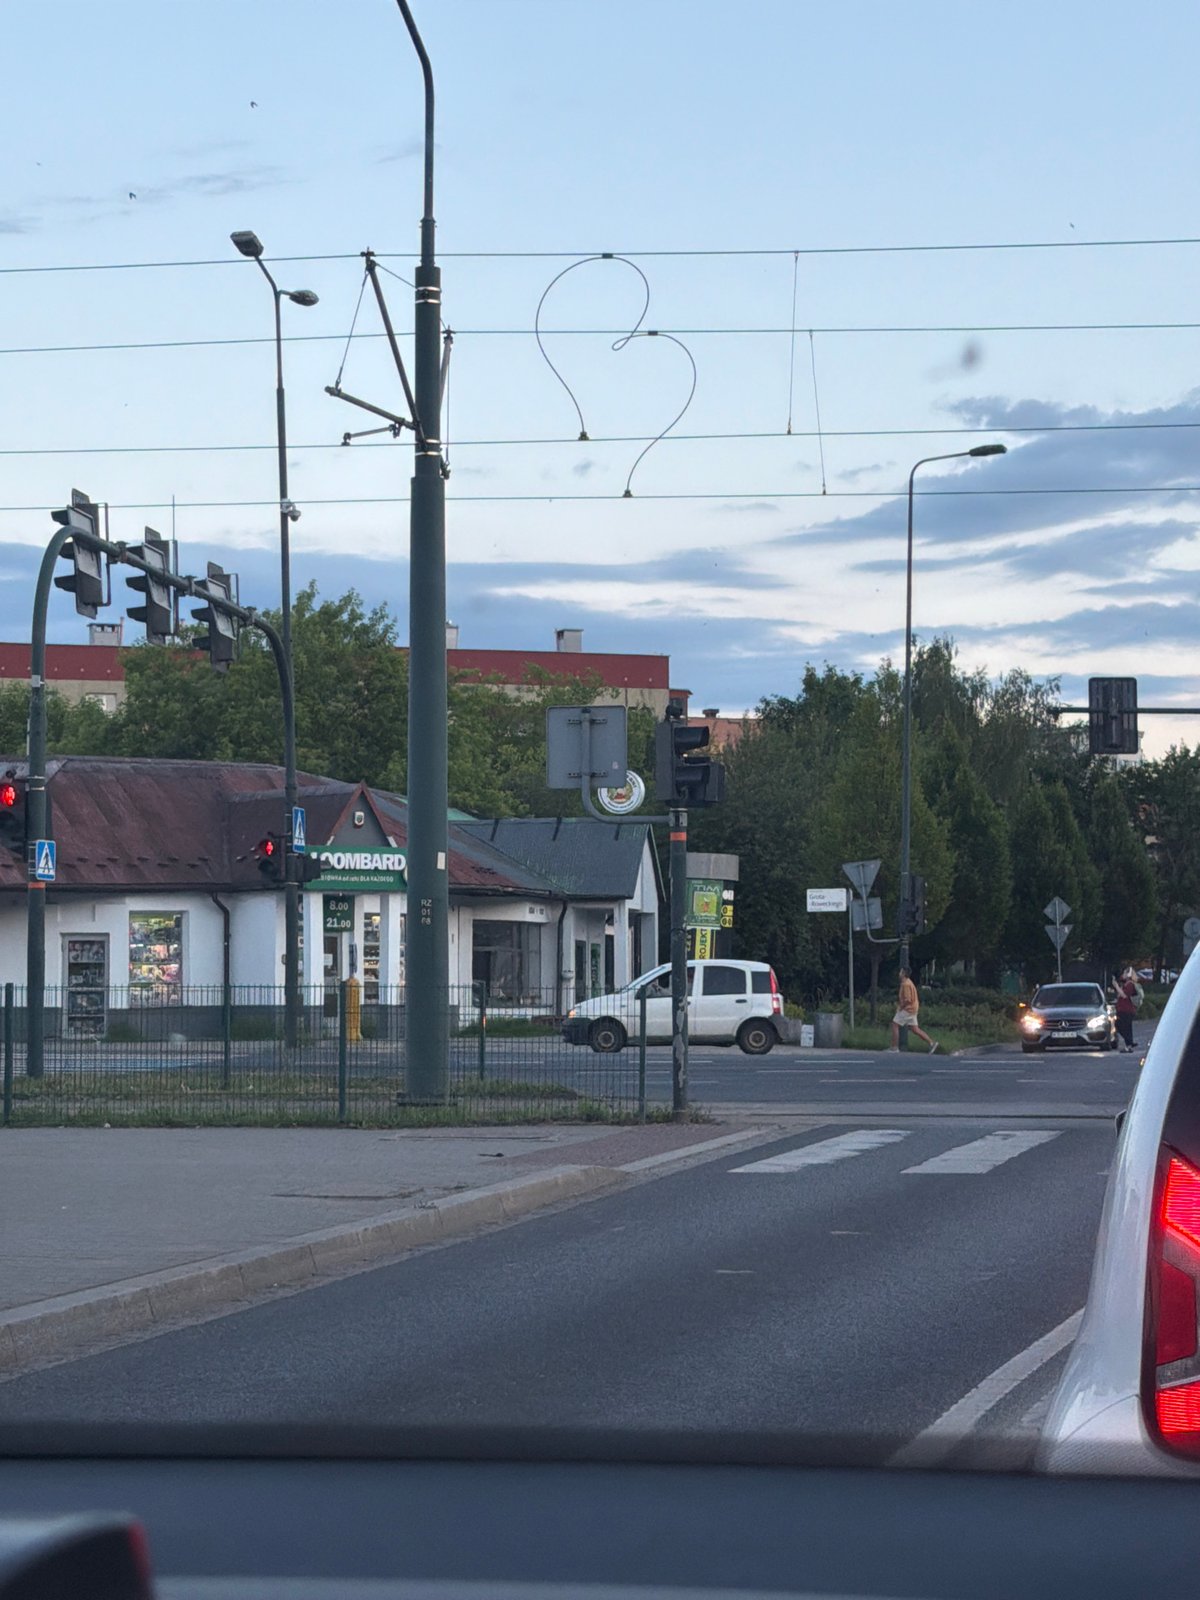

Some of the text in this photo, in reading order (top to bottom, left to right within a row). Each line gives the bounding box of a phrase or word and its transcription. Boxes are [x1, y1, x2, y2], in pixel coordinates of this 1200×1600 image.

[329, 901, 349, 911] 8.00
[421, 899, 432, 907] RZ
[326, 917, 351, 928] 21.00
[699, 928, 707, 959] ROJEKT
